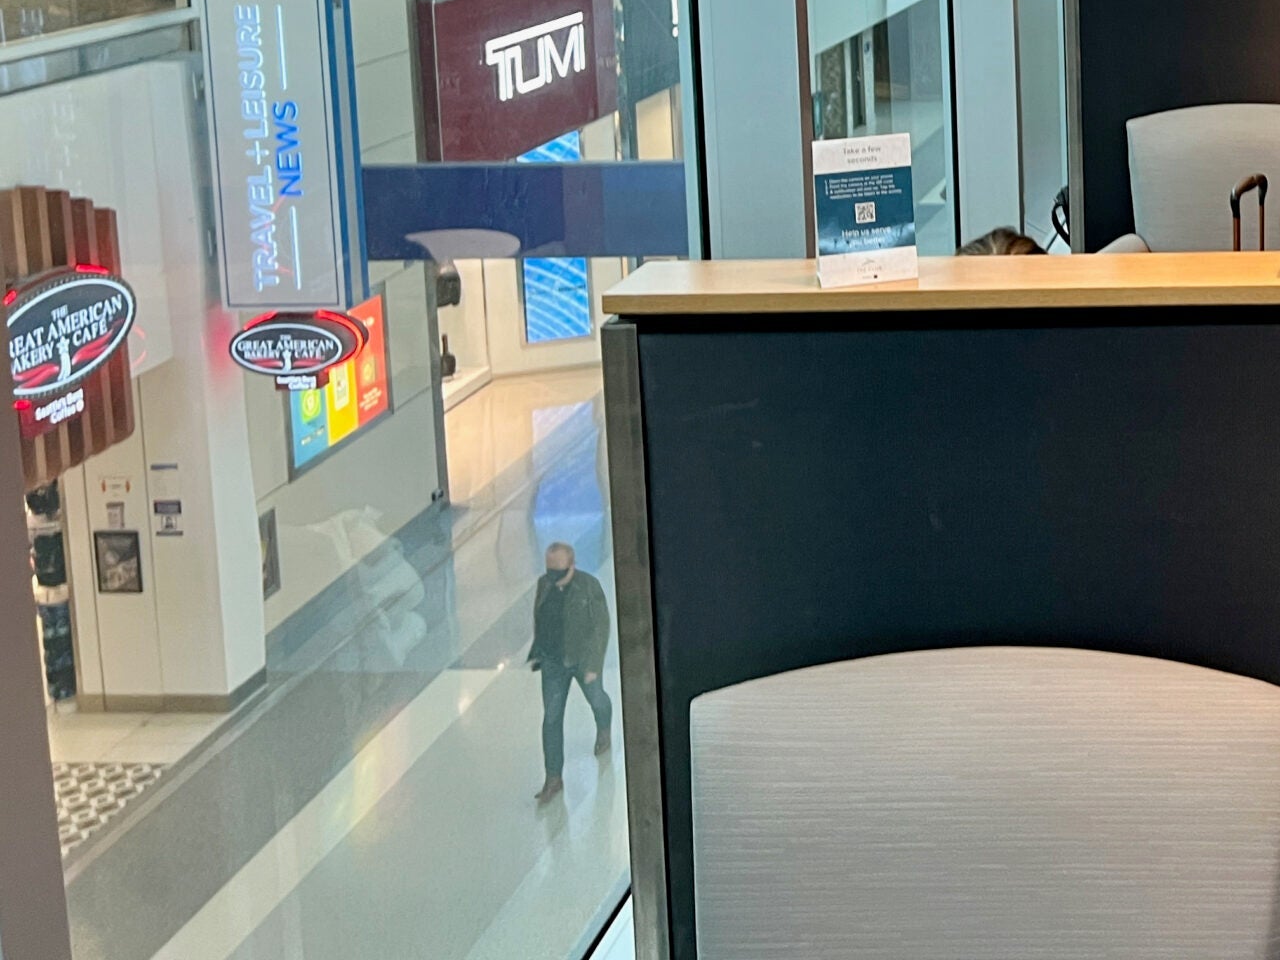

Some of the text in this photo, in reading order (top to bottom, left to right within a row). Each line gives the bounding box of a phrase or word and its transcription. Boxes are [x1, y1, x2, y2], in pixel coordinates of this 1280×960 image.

[485, 11, 585, 101] TUMI
[235, 3, 280, 293] TRAVEL + LEISURE
[273, 100, 303, 197] NEWS
[47, 294, 123, 339] AMERICAN
[51, 304, 69, 321] THE
[237, 338, 334, 352] GREAT AMERICAN
